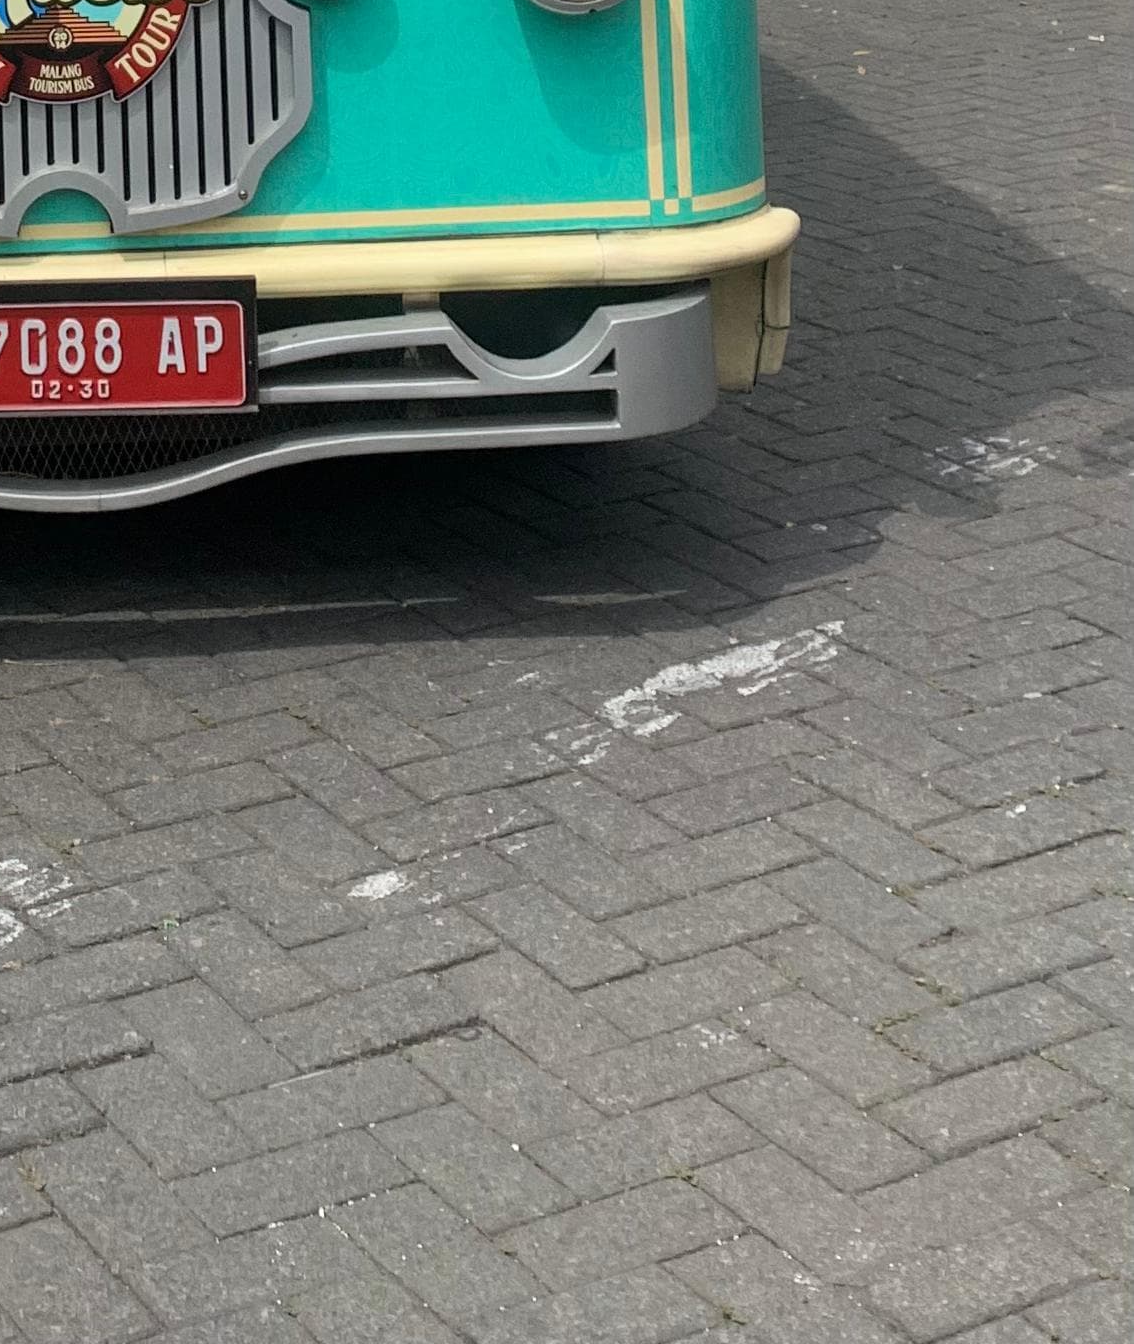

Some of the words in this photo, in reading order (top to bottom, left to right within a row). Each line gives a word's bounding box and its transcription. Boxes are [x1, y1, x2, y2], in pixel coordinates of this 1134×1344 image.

[114, 7, 182, 83] TOUR
[29, 77, 73, 94] TOURISM
[73, 76, 95, 92] BUS
[39, 63, 83, 78] MALANG
[157, 315, 224, 375] AP
